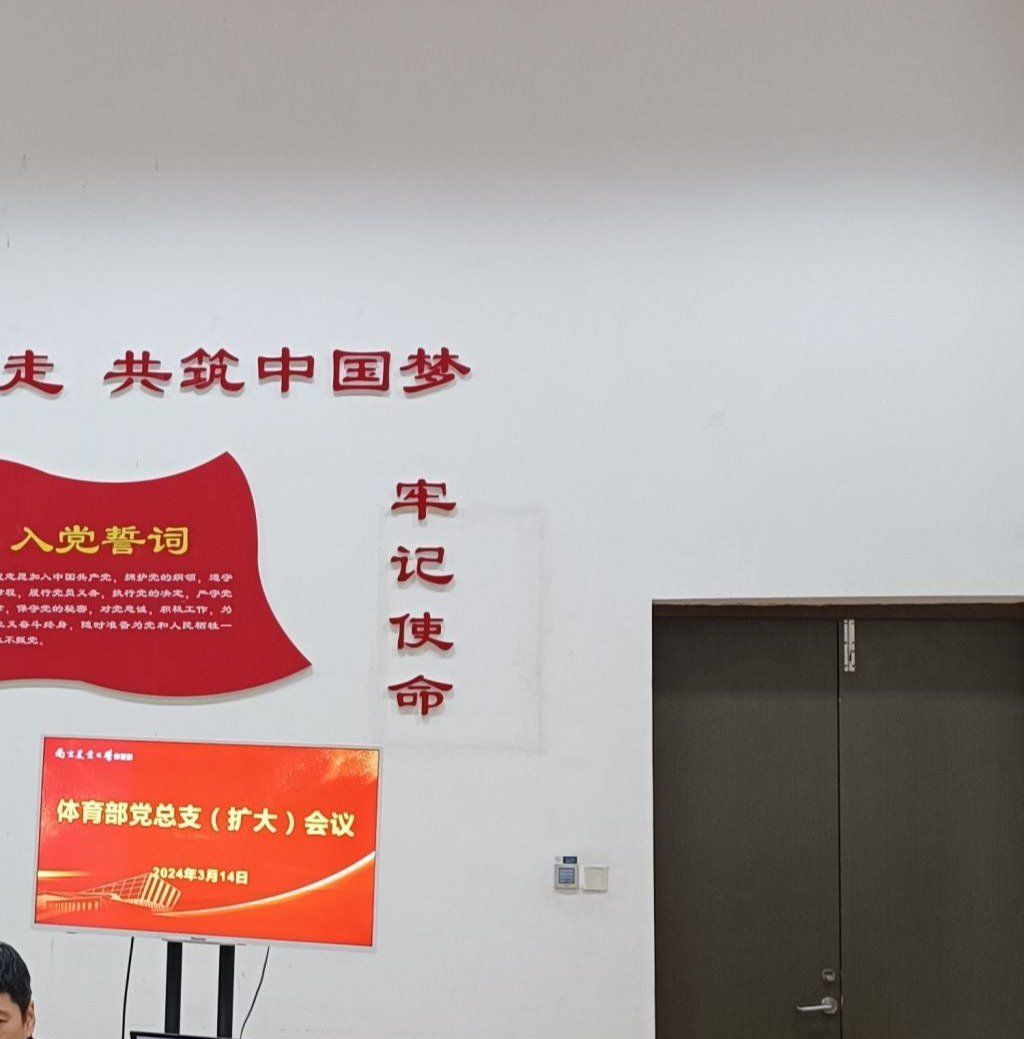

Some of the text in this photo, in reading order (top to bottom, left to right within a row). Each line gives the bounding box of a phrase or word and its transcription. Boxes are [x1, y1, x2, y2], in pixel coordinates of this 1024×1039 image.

[103, 347, 471, 394] 共筑中国梦
[10, 525, 189, 555] 入党誓词
[389, 479, 456, 715] 牢记使命
[56, 798, 355, 838] 体育部党总支（扩大）会议
[152, 866, 249, 885] 2024年3月14日
